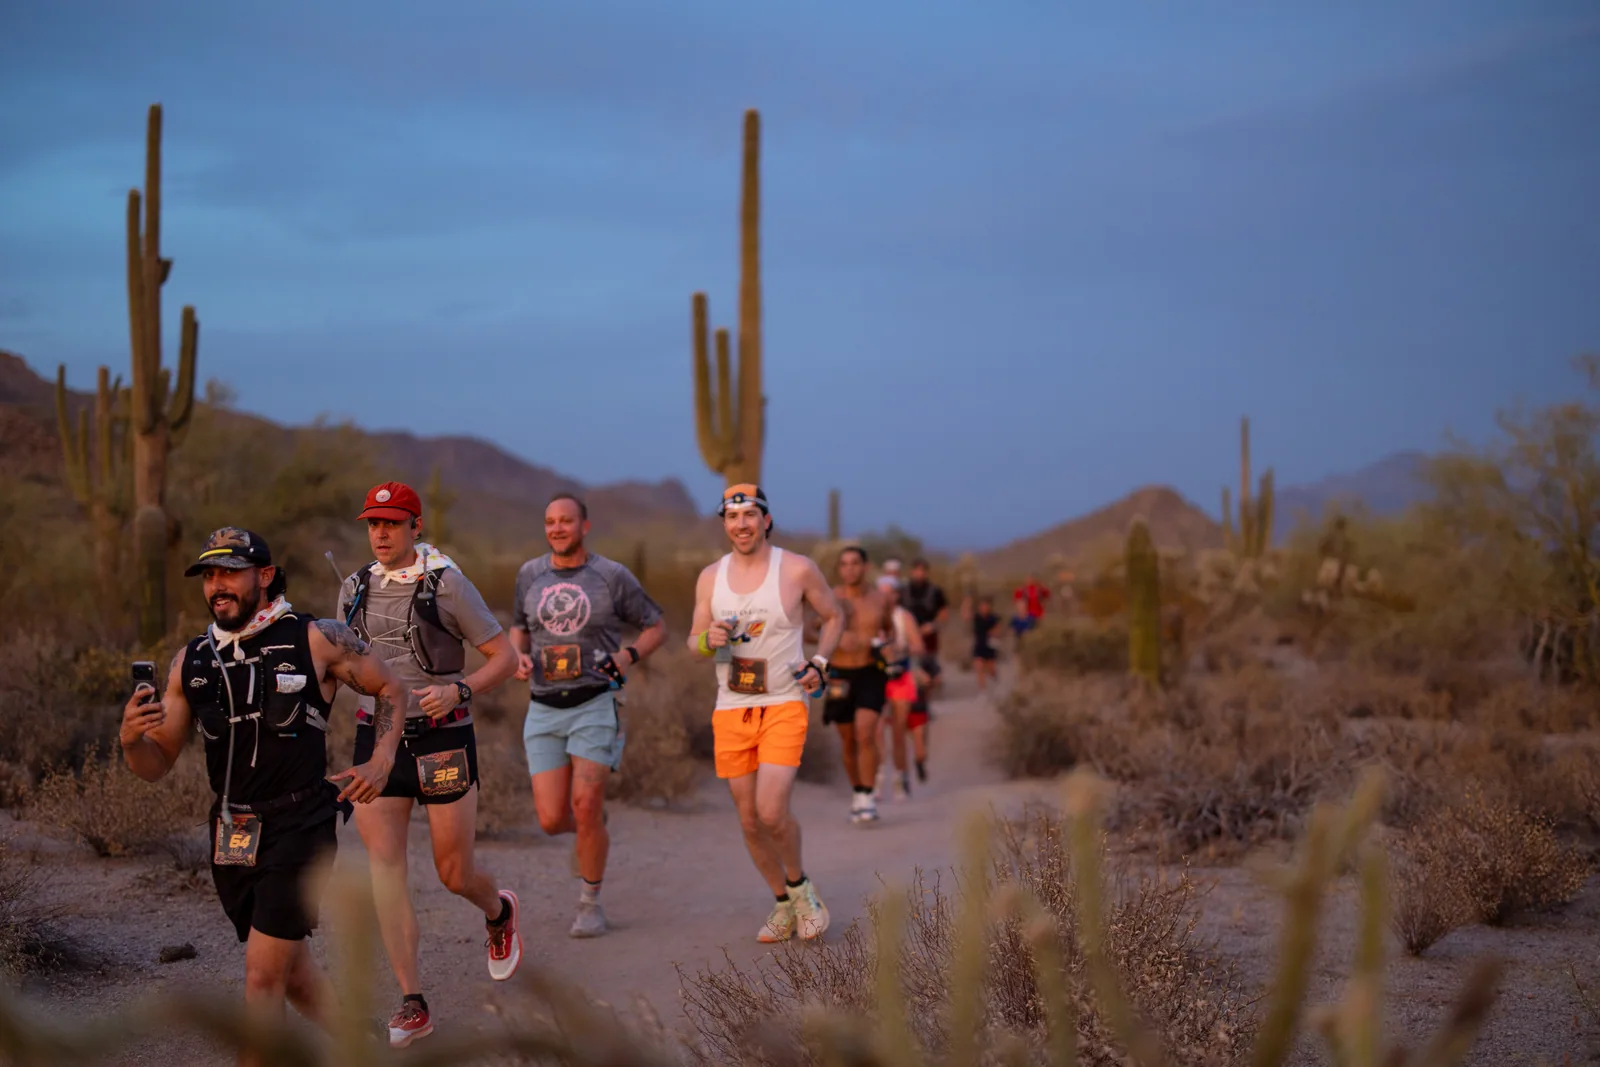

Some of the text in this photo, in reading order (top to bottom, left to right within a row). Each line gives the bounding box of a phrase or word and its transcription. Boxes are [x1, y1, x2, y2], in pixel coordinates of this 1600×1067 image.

[740, 672, 755, 684] 12
[433, 767, 459, 783] 32
[229, 834, 252, 849] 64
